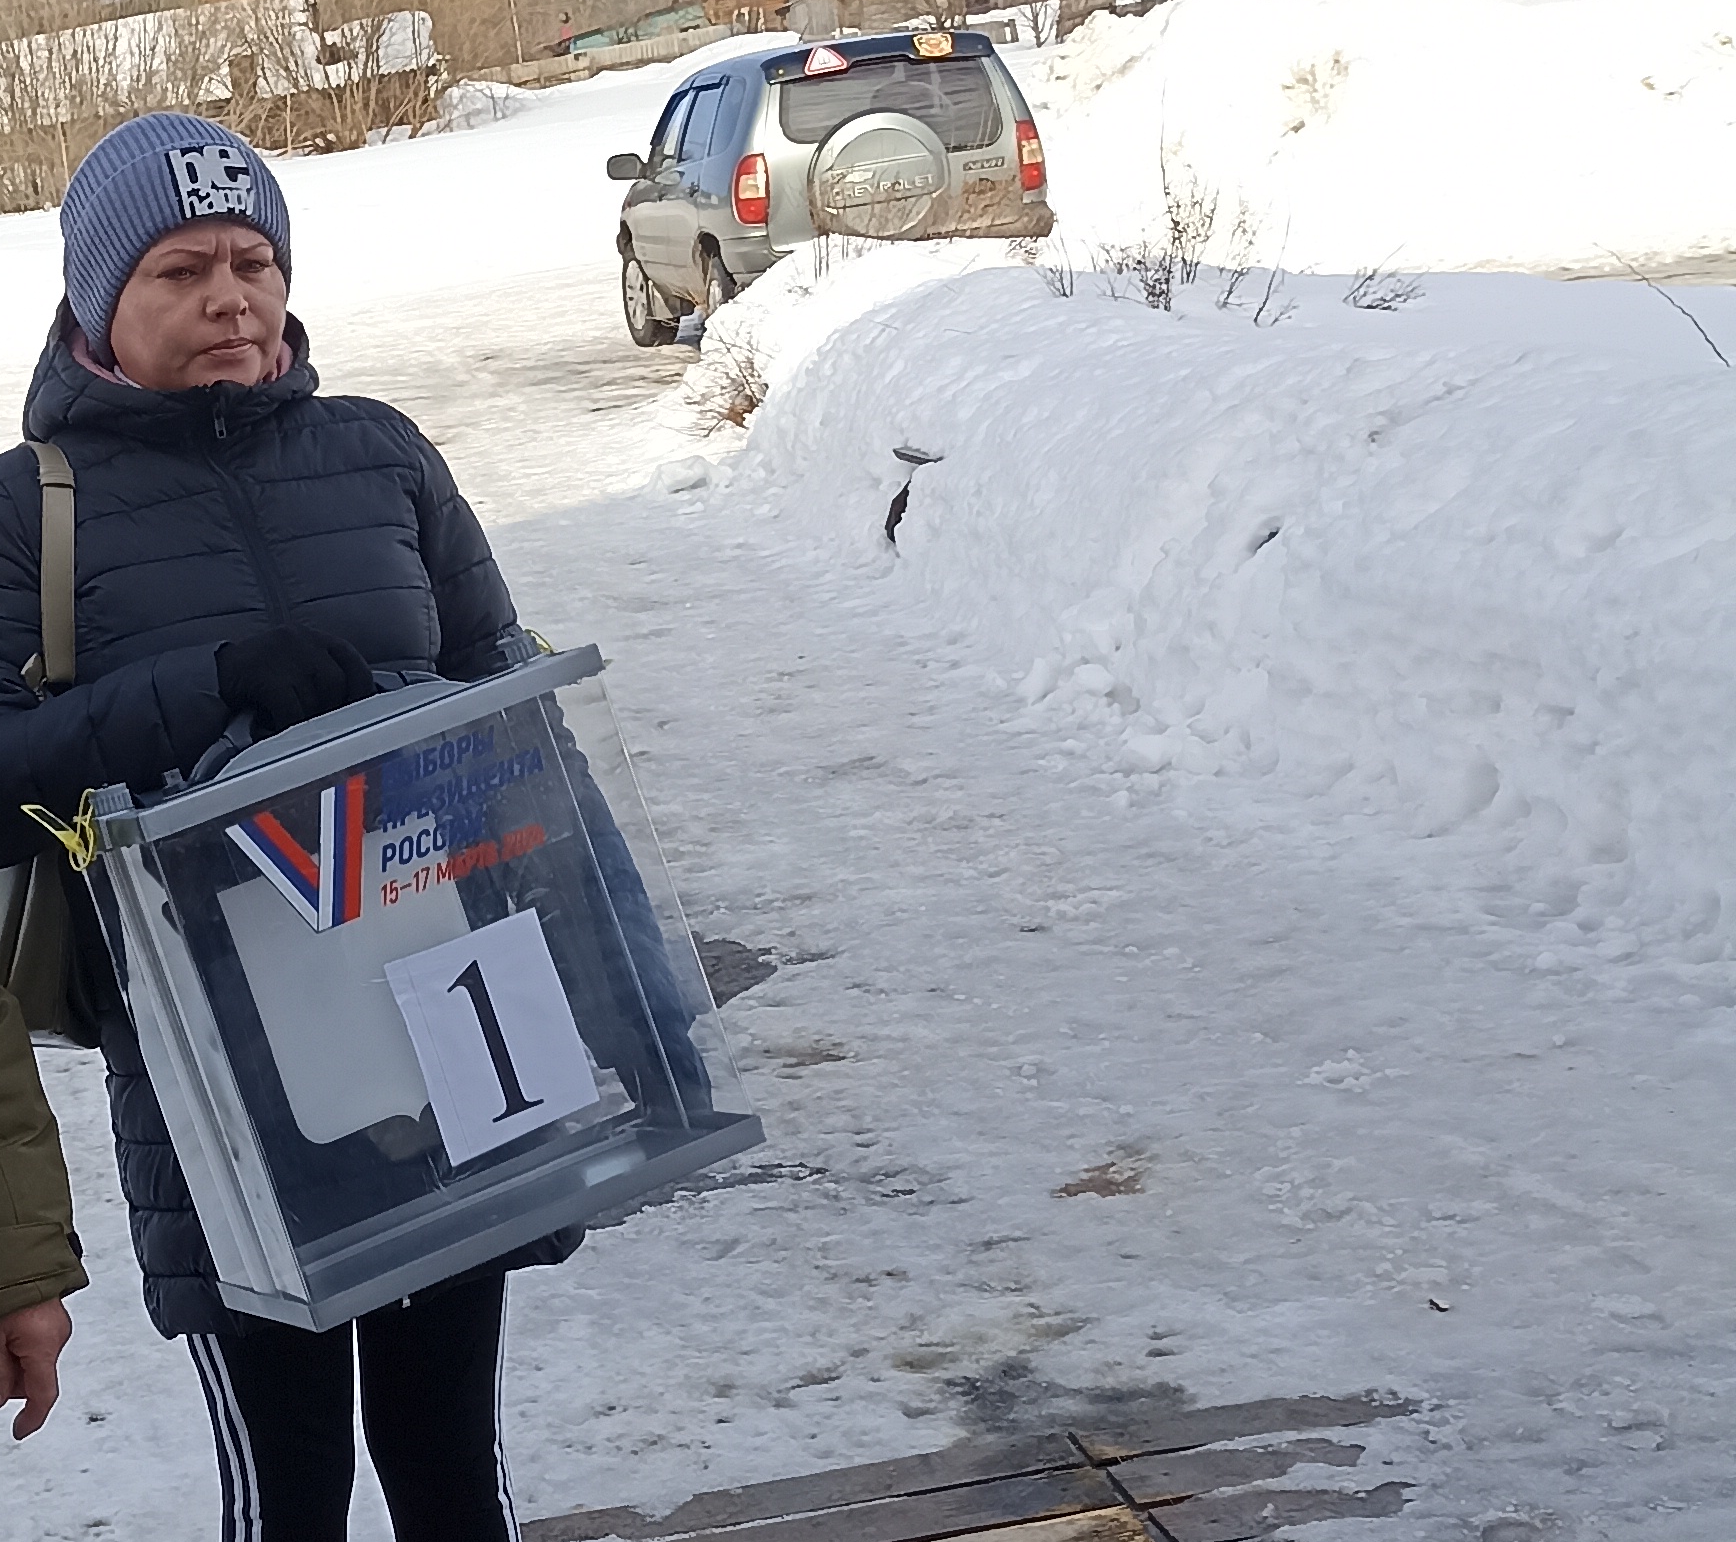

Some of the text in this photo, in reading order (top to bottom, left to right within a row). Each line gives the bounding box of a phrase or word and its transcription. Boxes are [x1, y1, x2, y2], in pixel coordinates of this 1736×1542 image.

[169, 146, 251, 190] be
[832, 173, 935, 199] CHEVROLET
[382, 724, 495, 788] БОРЫ
[381, 746, 544, 833] ЗИДЕНТА
[381, 814, 483, 872] РОСС
[436, 840, 499, 885] МРТ
[447, 959, 544, 1123] 1
